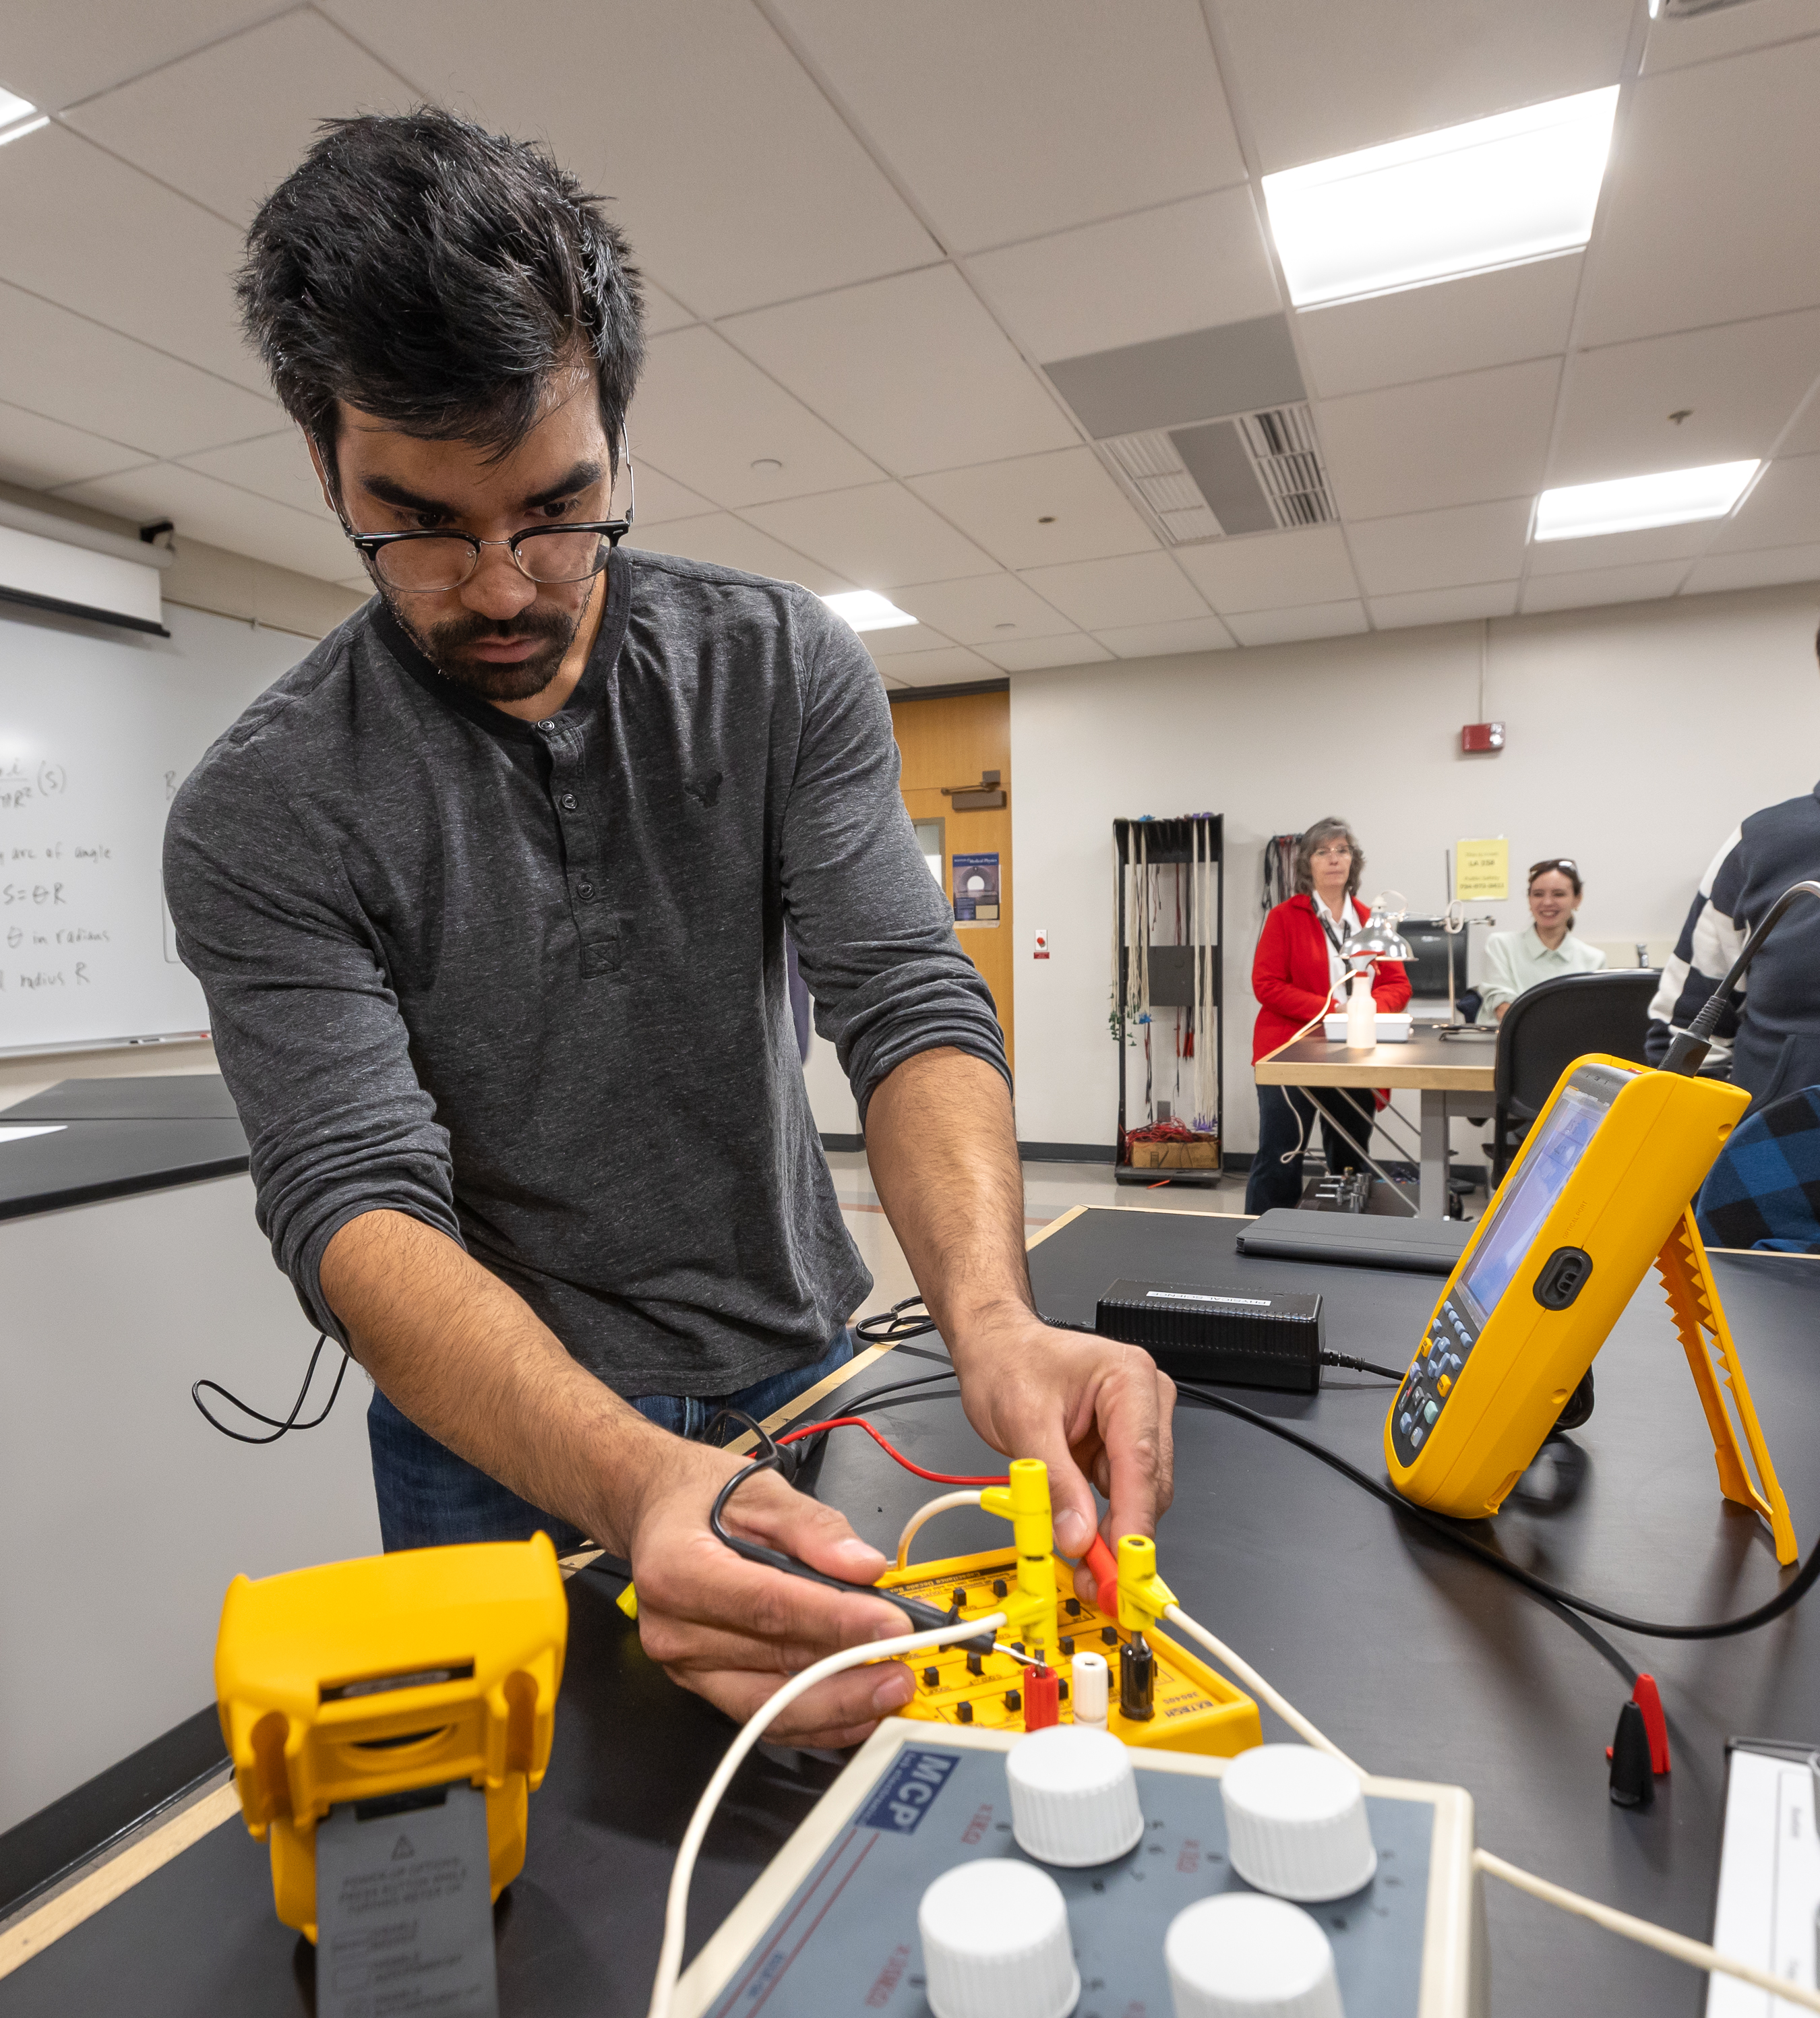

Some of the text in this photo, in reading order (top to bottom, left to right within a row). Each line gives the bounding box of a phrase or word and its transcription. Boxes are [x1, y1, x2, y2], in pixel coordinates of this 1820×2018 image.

[12, 847, 35, 860] arc
[46, 842, 62, 859] of
[74, 844, 111, 863] angle
[55, 927, 111, 945] radians
[20, 971, 66, 989] radius
[74, 961, 91, 985] R
[1563, 1200, 1587, 1239] OPTICAL PORT
[1205, 1296, 1266, 1305] PHYSICAL
[906, 1581, 934, 1591] Decade
[888, 1754, 951, 1827] MCP
